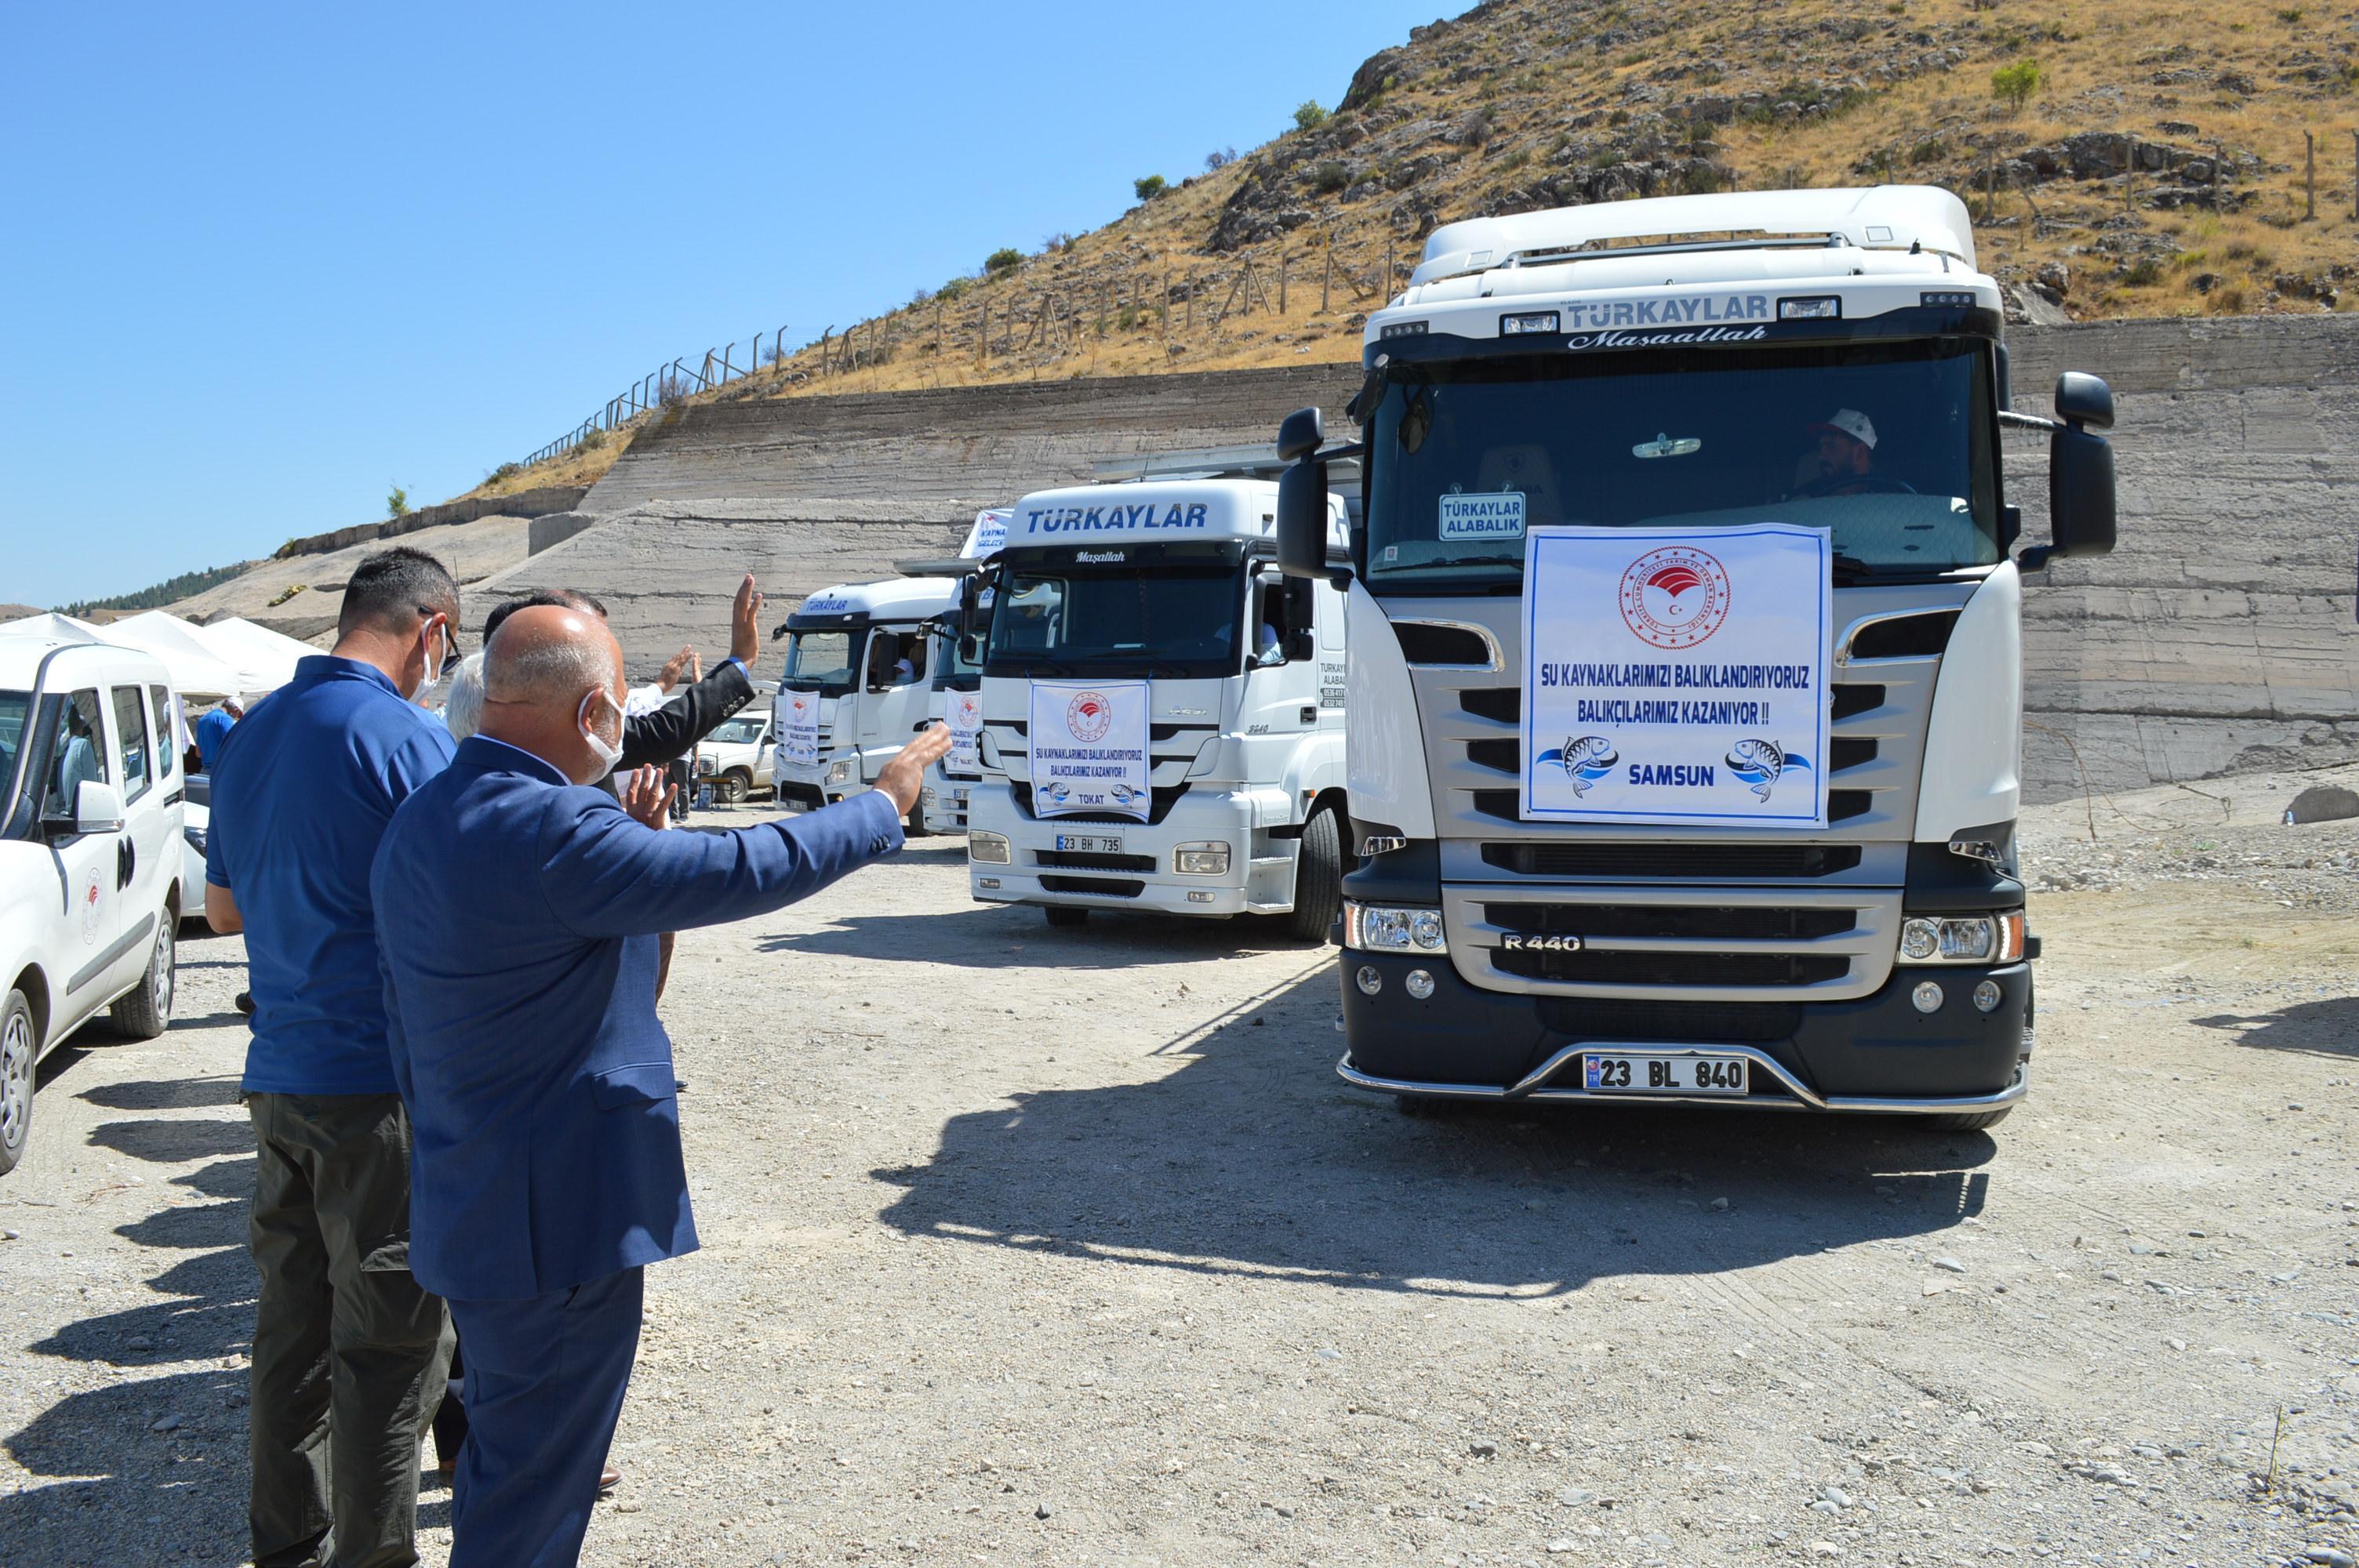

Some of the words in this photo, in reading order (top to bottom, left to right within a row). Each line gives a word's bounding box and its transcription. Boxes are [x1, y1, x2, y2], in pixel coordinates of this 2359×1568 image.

[1568, 295, 1768, 328] TÜRKAYLAR
[1568, 325, 1769, 350] Maşaallah
[1444, 500, 1520, 517] TÜRKAYLAR
[1027, 503, 1208, 533] TÜRKAYLAR
[1446, 518, 1519, 532] ALABALIK
[1075, 550, 1125, 564] Maşallah
[1541, 663, 1558, 687] SU
[1561, 663, 1671, 688] KAYNAKLARIMIZI
[1674, 665, 1809, 689] BALIKLANDIRIYORUZ
[1577, 699, 1678, 728] BALIKÇILARIMIZ
[1681, 701, 1758, 725] KAZANIYOR
[1761, 702, 1769, 725] !!
[1036, 748, 1043, 759] SU
[1044, 748, 1088, 760] KAYNAKLARIMIZI
[1089, 750, 1143, 761] BALIKLANDIRIYORUZ
[1051, 765, 1090, 779] BALIKÇILARIMIZ
[1091, 767, 1122, 778] KAZANIYOR
[1629, 764, 1714, 786] SAMSUN
[1078, 794, 1104, 804] TOKAT
[1064, 838, 1075, 849] 23
[1081, 838, 1093, 850] BH
[1102, 839, 1119, 851] 735
[1505, 935, 1522, 950] R
[1526, 935, 1580, 951] 440
[1587, 1074, 1599, 1083] TR
[1600, 1060, 1631, 1087] 23
[1648, 1061, 1680, 1087] BL
[1696, 1062, 1743, 1089] 840
